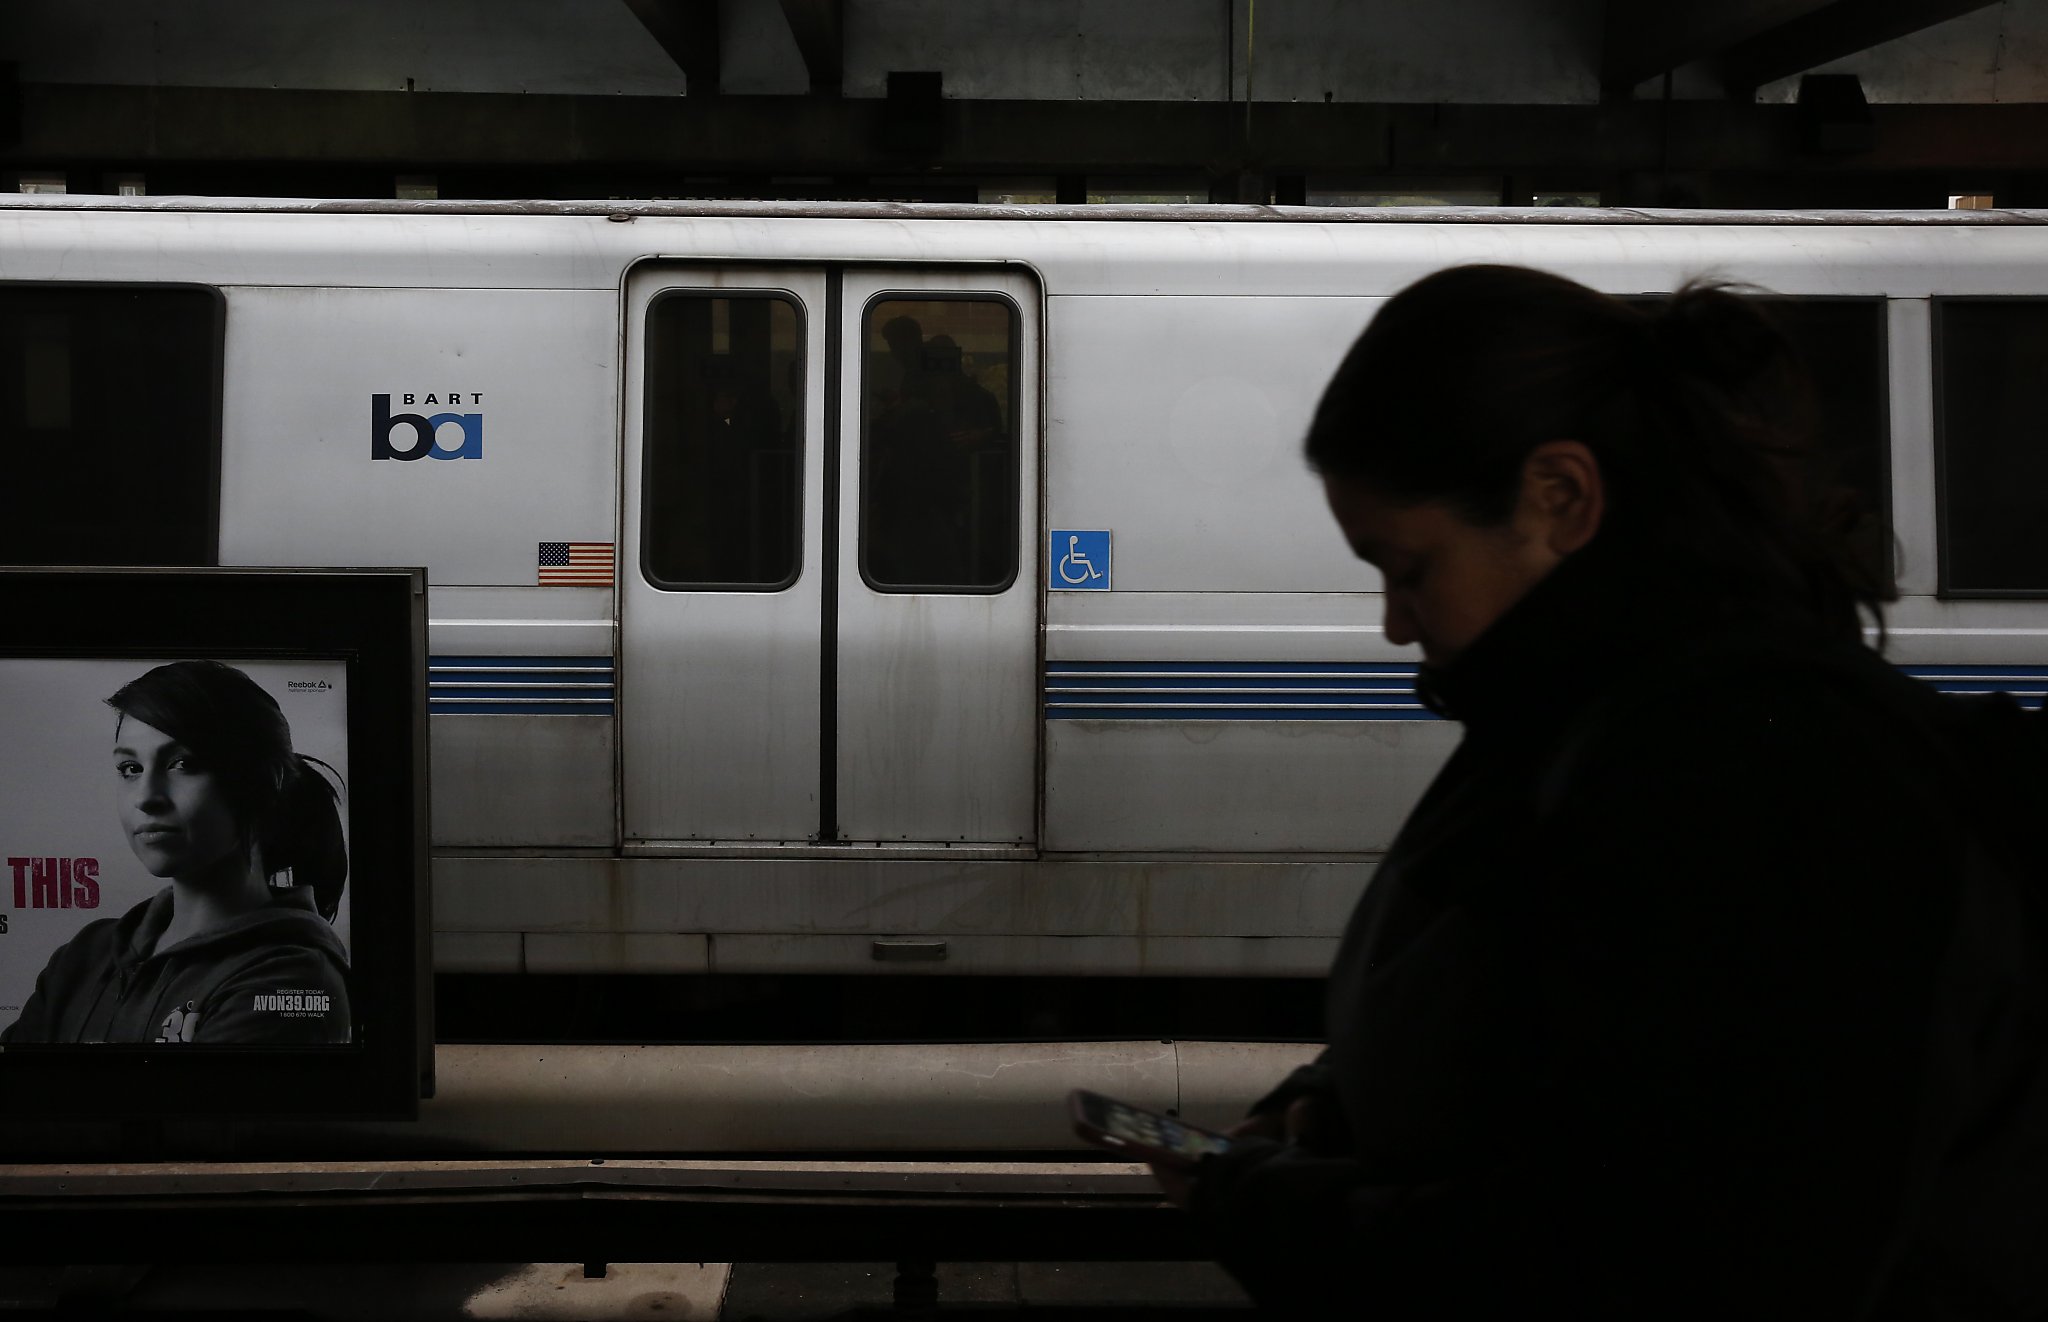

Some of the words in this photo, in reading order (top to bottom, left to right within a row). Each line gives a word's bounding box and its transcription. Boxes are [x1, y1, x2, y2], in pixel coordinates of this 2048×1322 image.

[403, 393, 482, 405] BART
[8, 857, 99, 908] THIS
[253, 995, 330, 1011] AVON39.ORG
